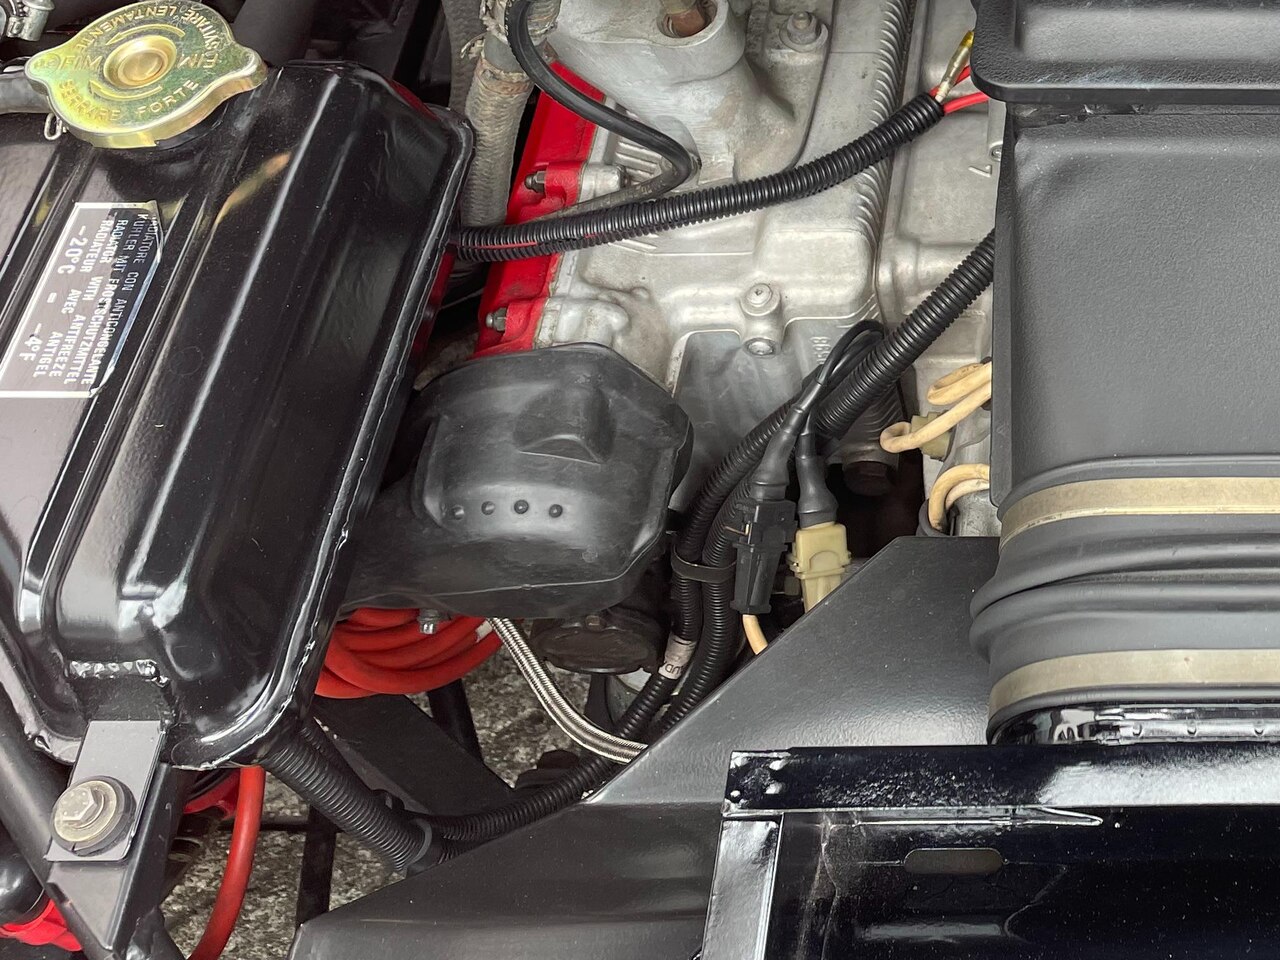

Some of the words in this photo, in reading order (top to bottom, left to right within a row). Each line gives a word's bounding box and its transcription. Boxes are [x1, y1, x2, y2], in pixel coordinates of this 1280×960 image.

[73, 4, 178, 52] LENTAMENTE
[181, 9, 220, 50] SVITARE
[58, 79, 121, 121] SERRARE
[136, 79, 199, 116] FORTE
[79, 219, 115, 273] RADIATEUR
[100, 219, 129, 264] RADIATOR
[111, 255, 130, 273] MIT
[121, 271, 140, 291] CON
[61, 289, 82, 314] AVEC
[82, 276, 104, 301] WITH
[32, 331, 63, 378] ANTIGEL
[49, 314, 86, 377] ANTIFREEZE
[81, 298, 128, 385] ANTICONGELANTE
